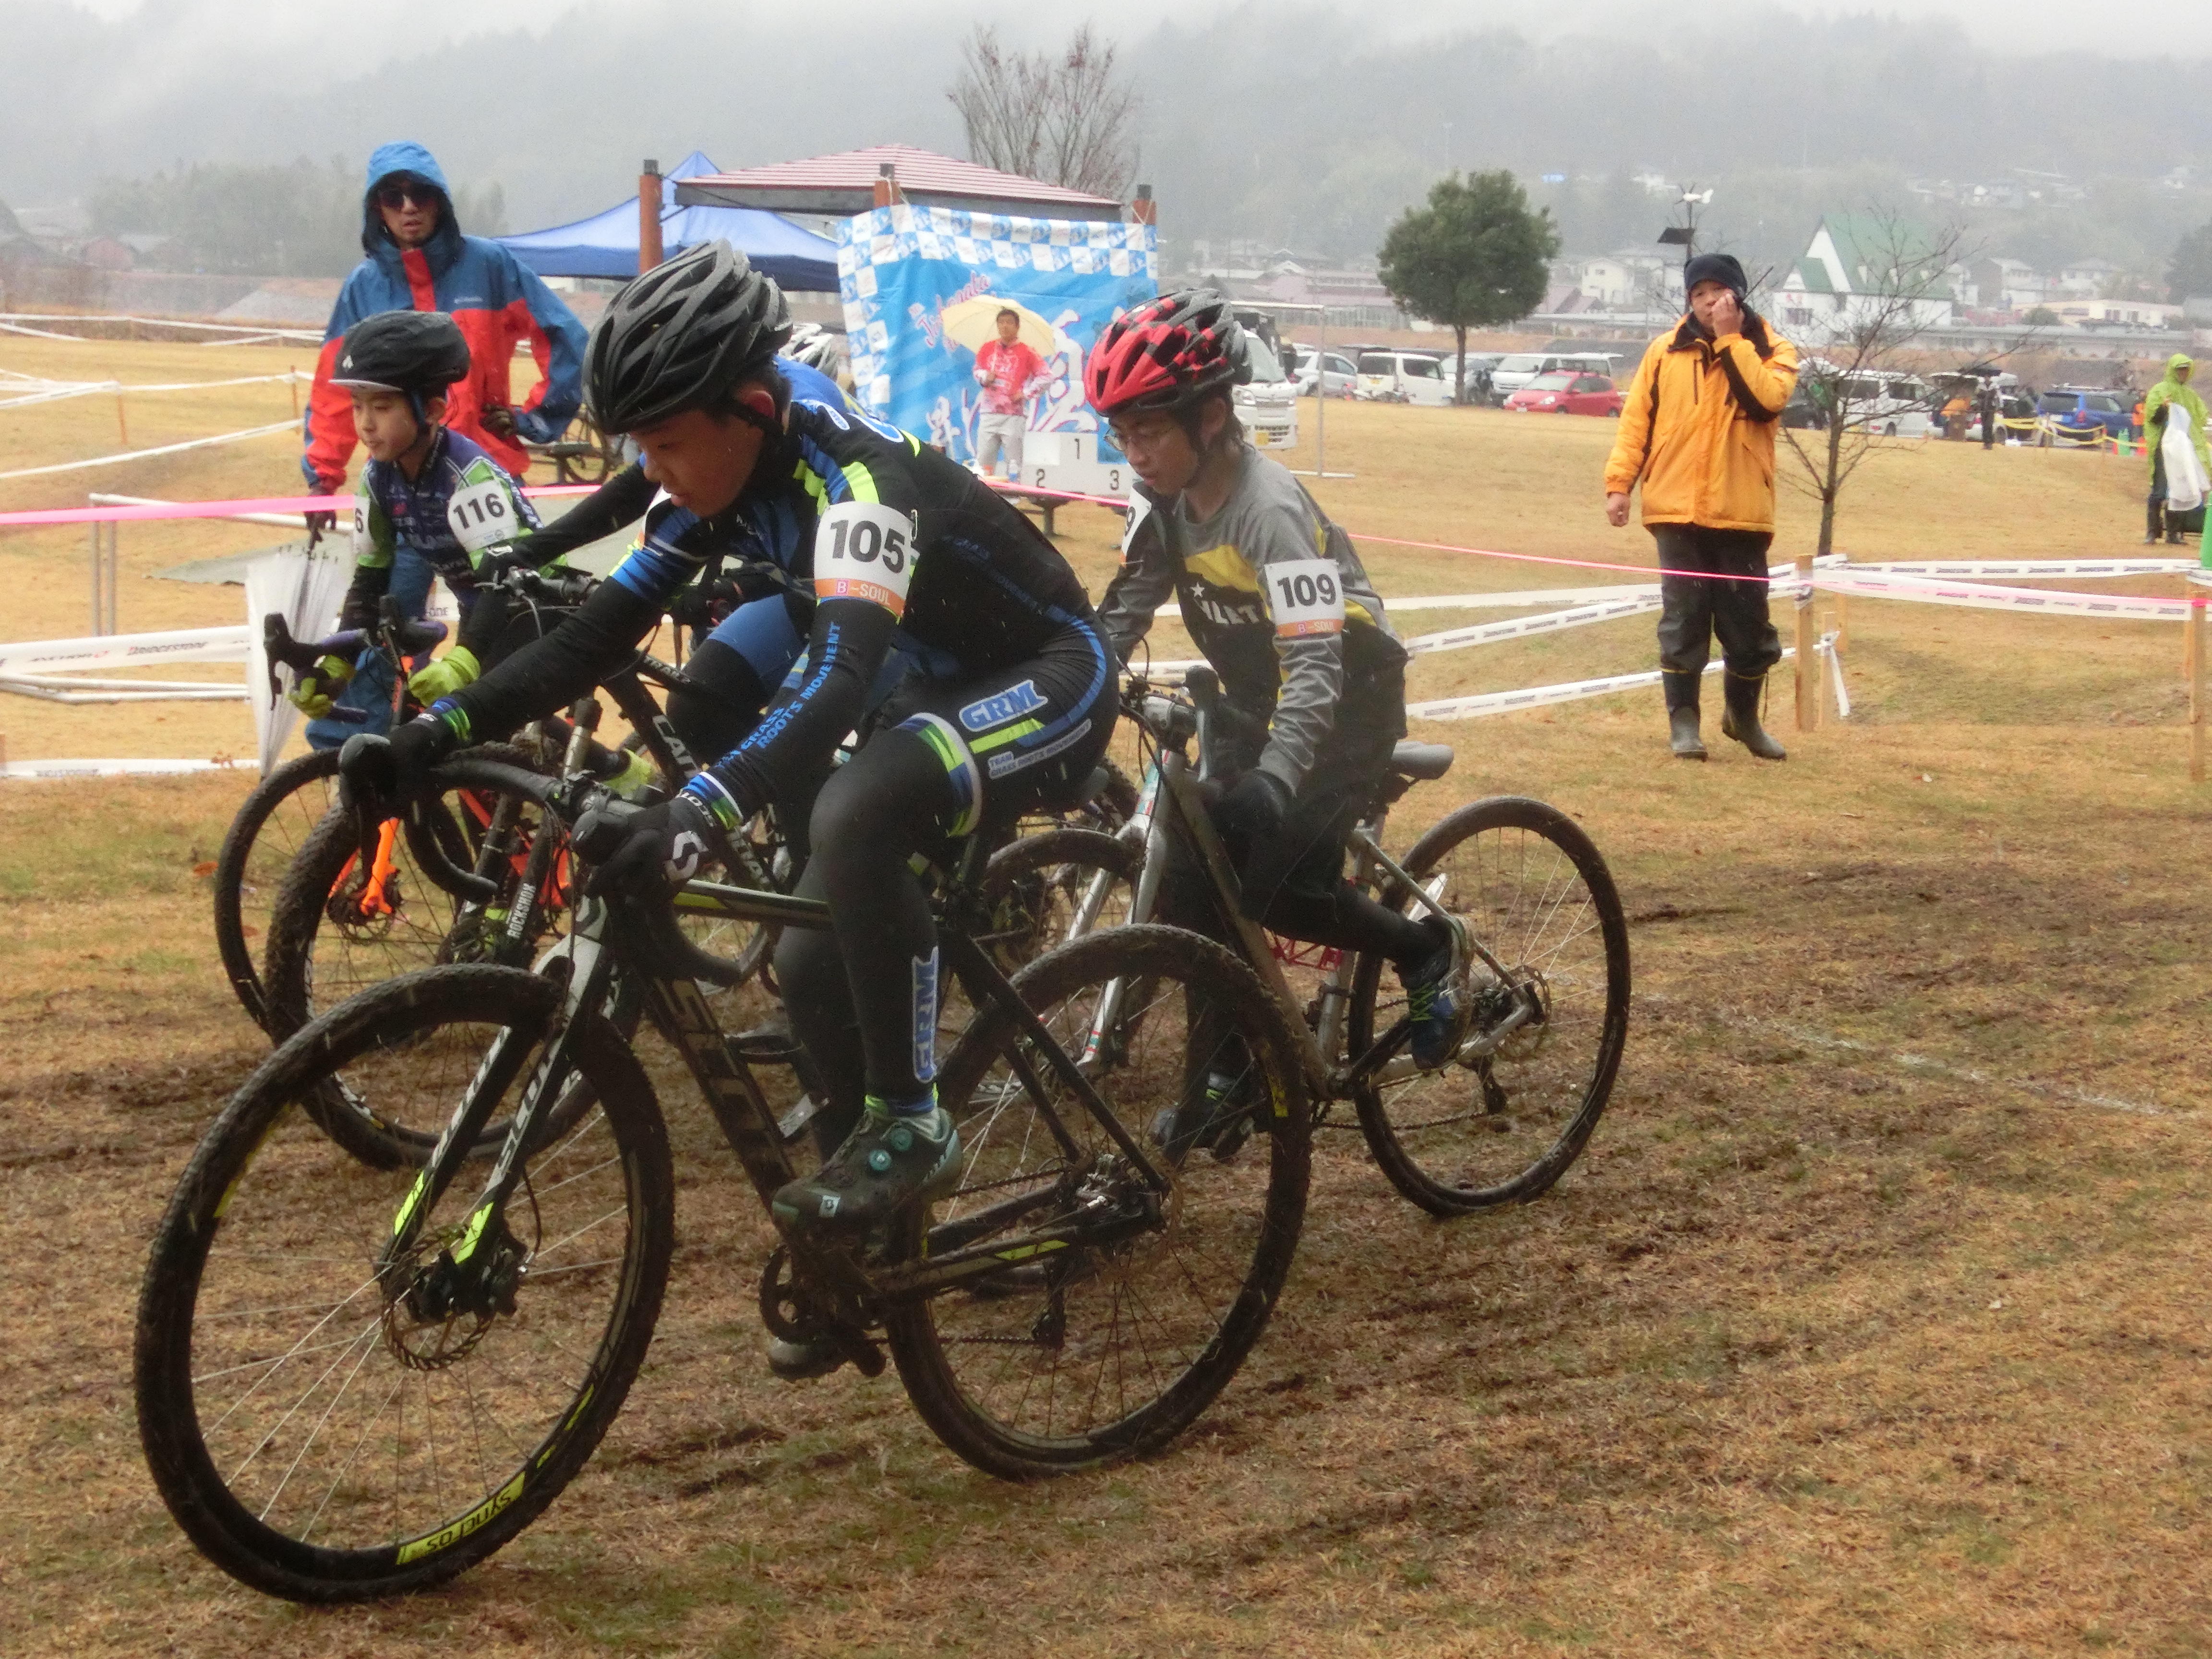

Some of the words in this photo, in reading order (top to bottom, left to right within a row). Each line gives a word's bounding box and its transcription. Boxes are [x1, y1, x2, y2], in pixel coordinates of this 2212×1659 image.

[1074, 438, 1080, 459] 1
[1036, 468, 1046, 488] 2
[1109, 469, 1119, 491] 3
[453, 493, 505, 529] 116
[830, 519, 905, 574] 105
[1277, 574, 1336, 608] 109
[756, 701, 804, 749] ROOTS
[800, 622, 841, 700] MOVEMENT
[961, 680, 1047, 731] GRM
